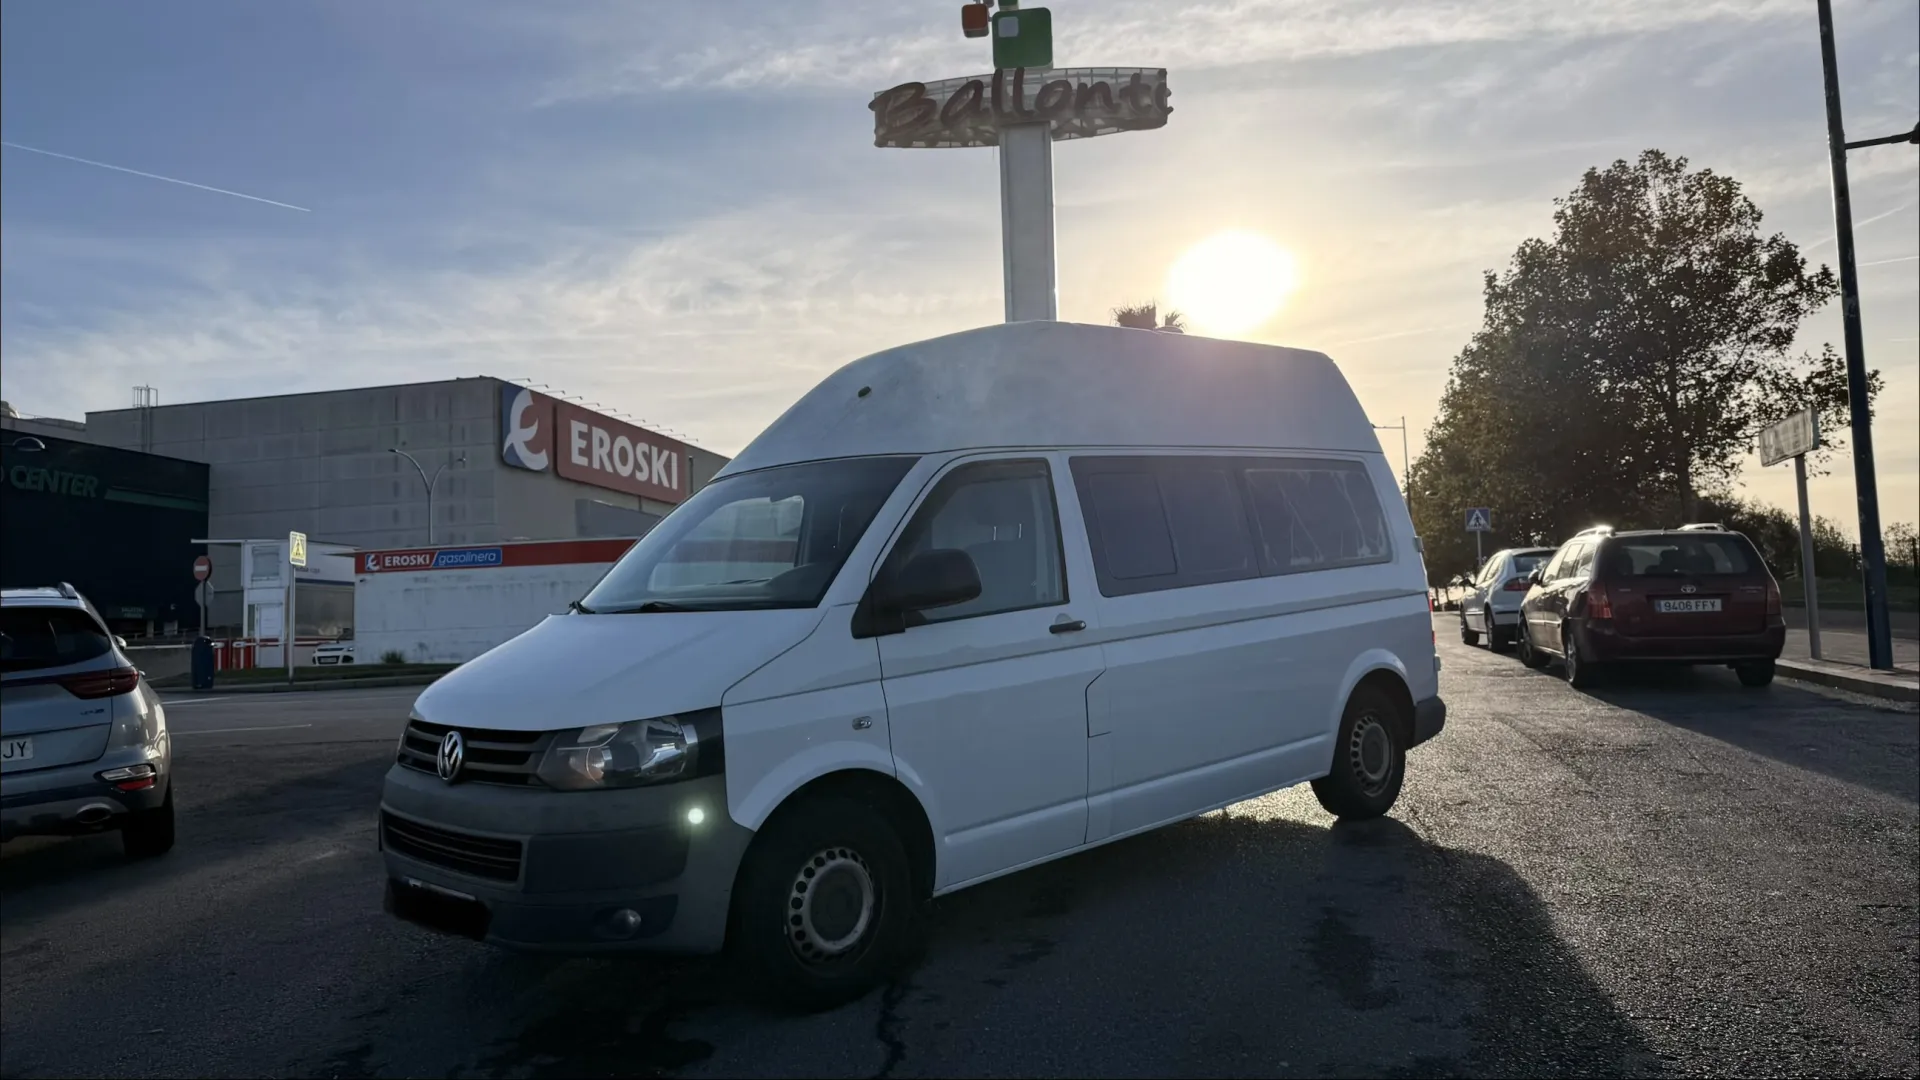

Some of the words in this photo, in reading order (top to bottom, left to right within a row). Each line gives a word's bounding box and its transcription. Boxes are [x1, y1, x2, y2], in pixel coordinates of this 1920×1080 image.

[868, 67, 1173, 127] Ballonti
[570, 420, 678, 490] EROSKI
[10, 465, 99, 498] CENTER
[385, 554, 430, 567] EROSKI
[438, 552, 497, 566] gasolinera
[1664, 600, 1693, 611] 9406
[1695, 600, 1716, 610] FFY
[3, 741, 27, 758] JY
